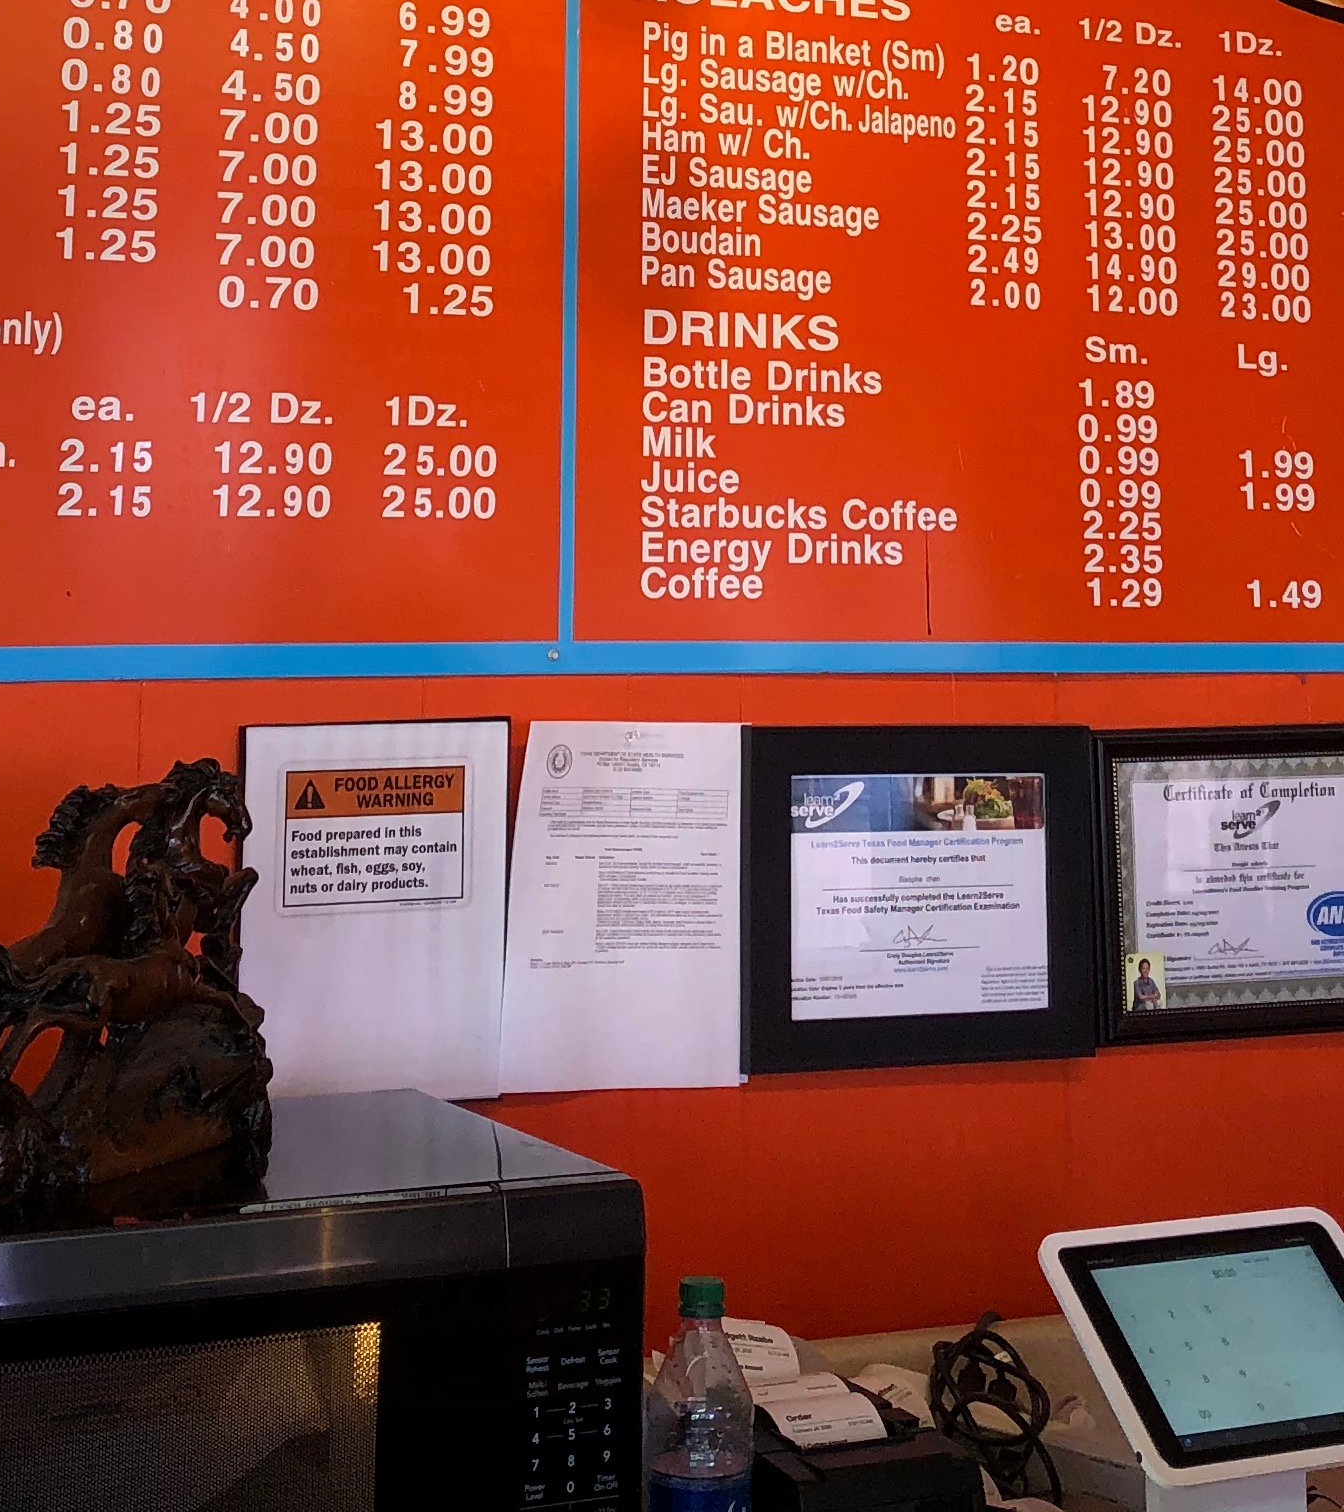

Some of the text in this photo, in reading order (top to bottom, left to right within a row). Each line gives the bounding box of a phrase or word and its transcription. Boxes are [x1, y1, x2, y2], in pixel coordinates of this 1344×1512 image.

[400, 2, 489, 37] 6.99
[996, 15, 1282, 54] ea. 1/2 Dz. 1Dz.
[644, 22, 1301, 106] Pig in a Blanket (Sm) 1.20 7.20 14.00
[644, 55, 907, 101] Lg. Sausage w/Ch.
[644, 88, 955, 142] Lg. Sau. w/Ch. Jalapeno
[643, 121, 809, 159] Ham w/ Ch.
[643, 188, 878, 236] Maeker Sausage
[643, 222, 760, 256] Boudain
[645, 310, 1287, 376] DRINKS Sm. Lg.
[644, 357, 1154, 408] Bottle Drinks 1.89
[59, 439, 152, 472] 2.15
[215, 441, 332, 475] 12.90
[384, 443, 496, 477] 25.00
[643, 426, 715, 457] Milk
[641, 461, 739, 493] Juice
[642, 496, 957, 531] Starbucks Coffee
[641, 567, 1321, 608] Coffee 1.29 1.49
[335, 774, 454, 791] FOOD ALLERGY
[1164, 781, 1335, 803] Certificate of Completion
[356, 793, 434, 808] WARNING
[291, 841, 457, 859] establishment may contain
[292, 826, 422, 844] Food prepared in this
[290, 861, 425, 876] wheat, fish, eggs, soy,
[290, 877, 428, 894] nuts or dairy products.
[786, 1413, 812, 1423] Order
